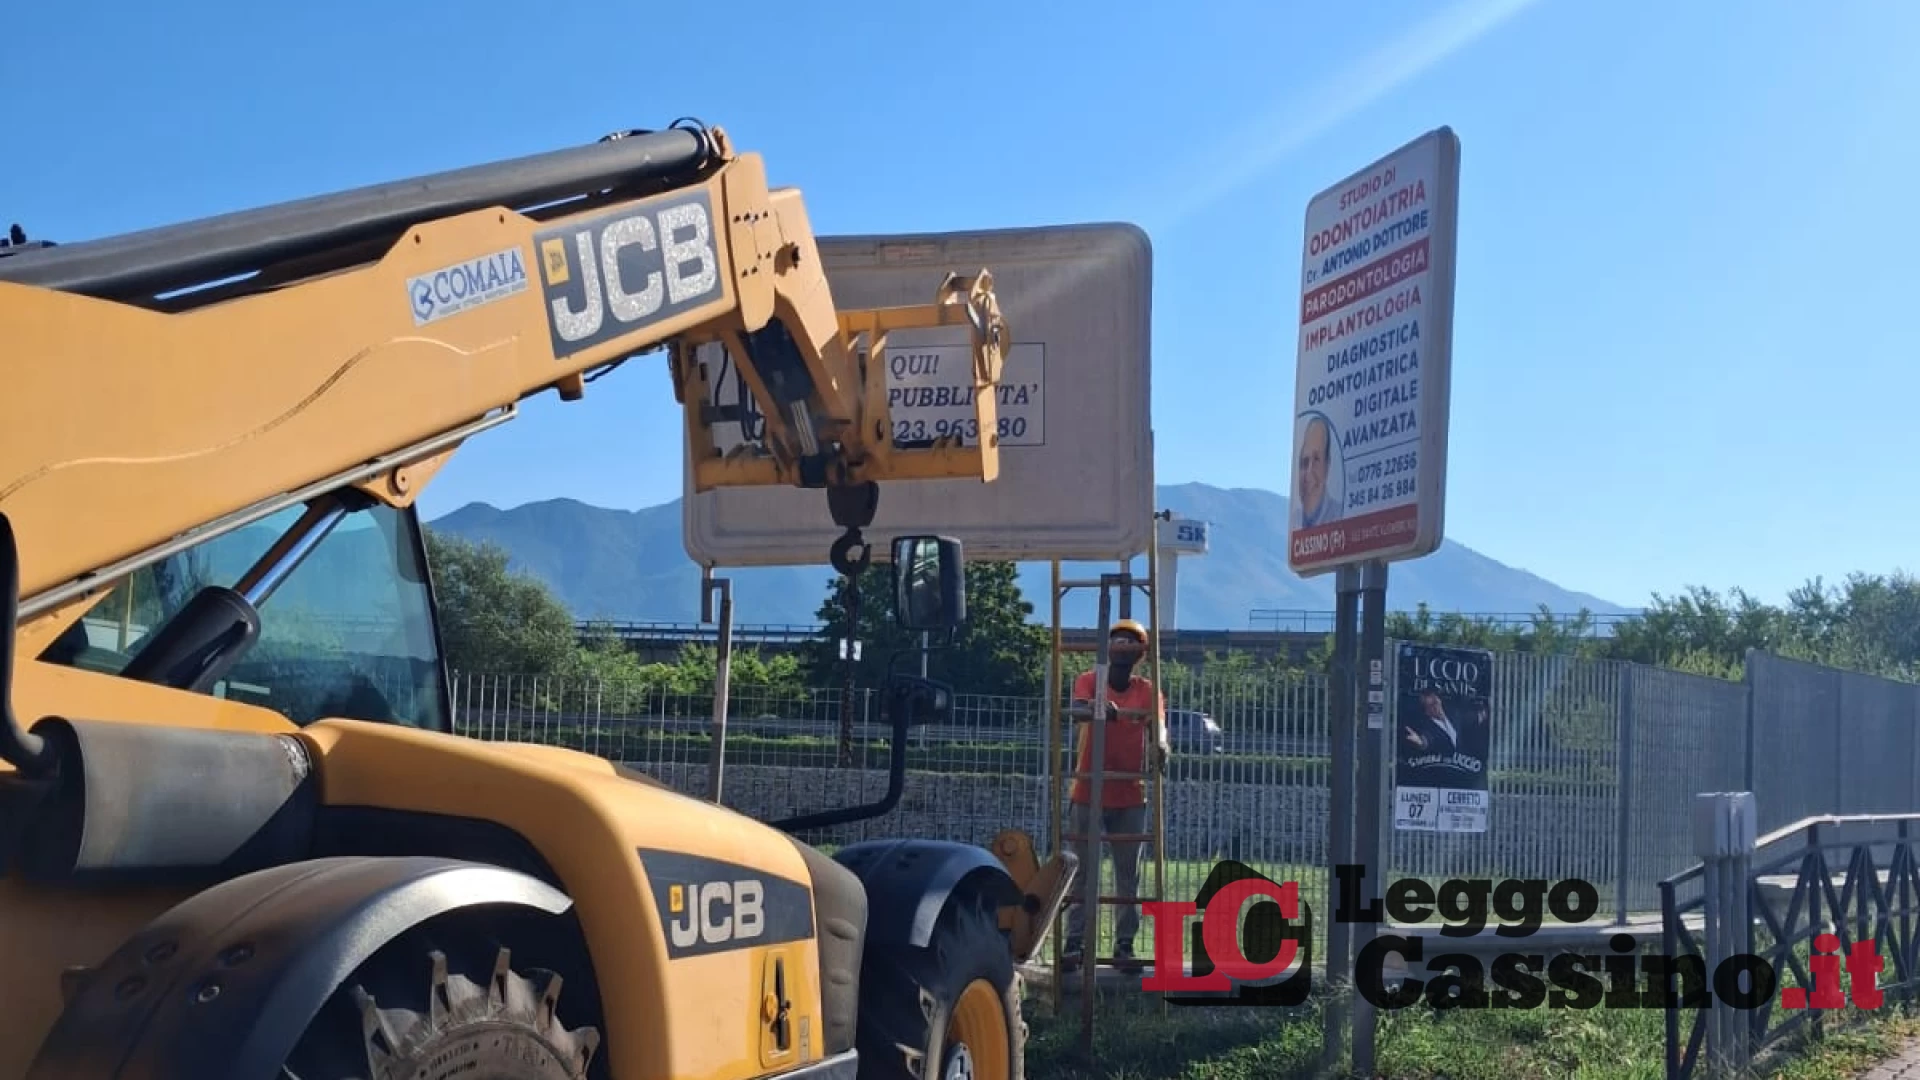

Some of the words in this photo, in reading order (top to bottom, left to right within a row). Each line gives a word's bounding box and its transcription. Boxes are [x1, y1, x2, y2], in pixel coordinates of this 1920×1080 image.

[1340, 175, 1381, 210] STUDIO
[1384, 167, 1396, 187] DI
[1310, 179, 1425, 256] ODONTOIATRIA
[1321, 238, 1370, 276] ANTONIO
[1373, 209, 1429, 252] DOTTORE
[434, 250, 526, 304] COMAIA
[552, 203, 716, 341] JCB
[1304, 247, 1426, 317] PARODONTOLOGIA
[1305, 285, 1422, 351] IMPLANTOLOGIA
[890, 354, 940, 380] QUI!
[1328, 320, 1419, 373] DIAGNOSTICA
[888, 383, 1038, 409] PUBBLITA'
[1308, 350, 1418, 406] ODONTOIATRICA
[1354, 379, 1417, 418] DIGITALE
[891, 416, 1027, 440] 23.96380
[1343, 409, 1416, 448] AVANZATA
[1358, 461, 1381, 483] 0776
[1294, 533, 1329, 557] CASSINO
[1409, 804, 1424, 818] 07
[671, 880, 764, 948] JCB
